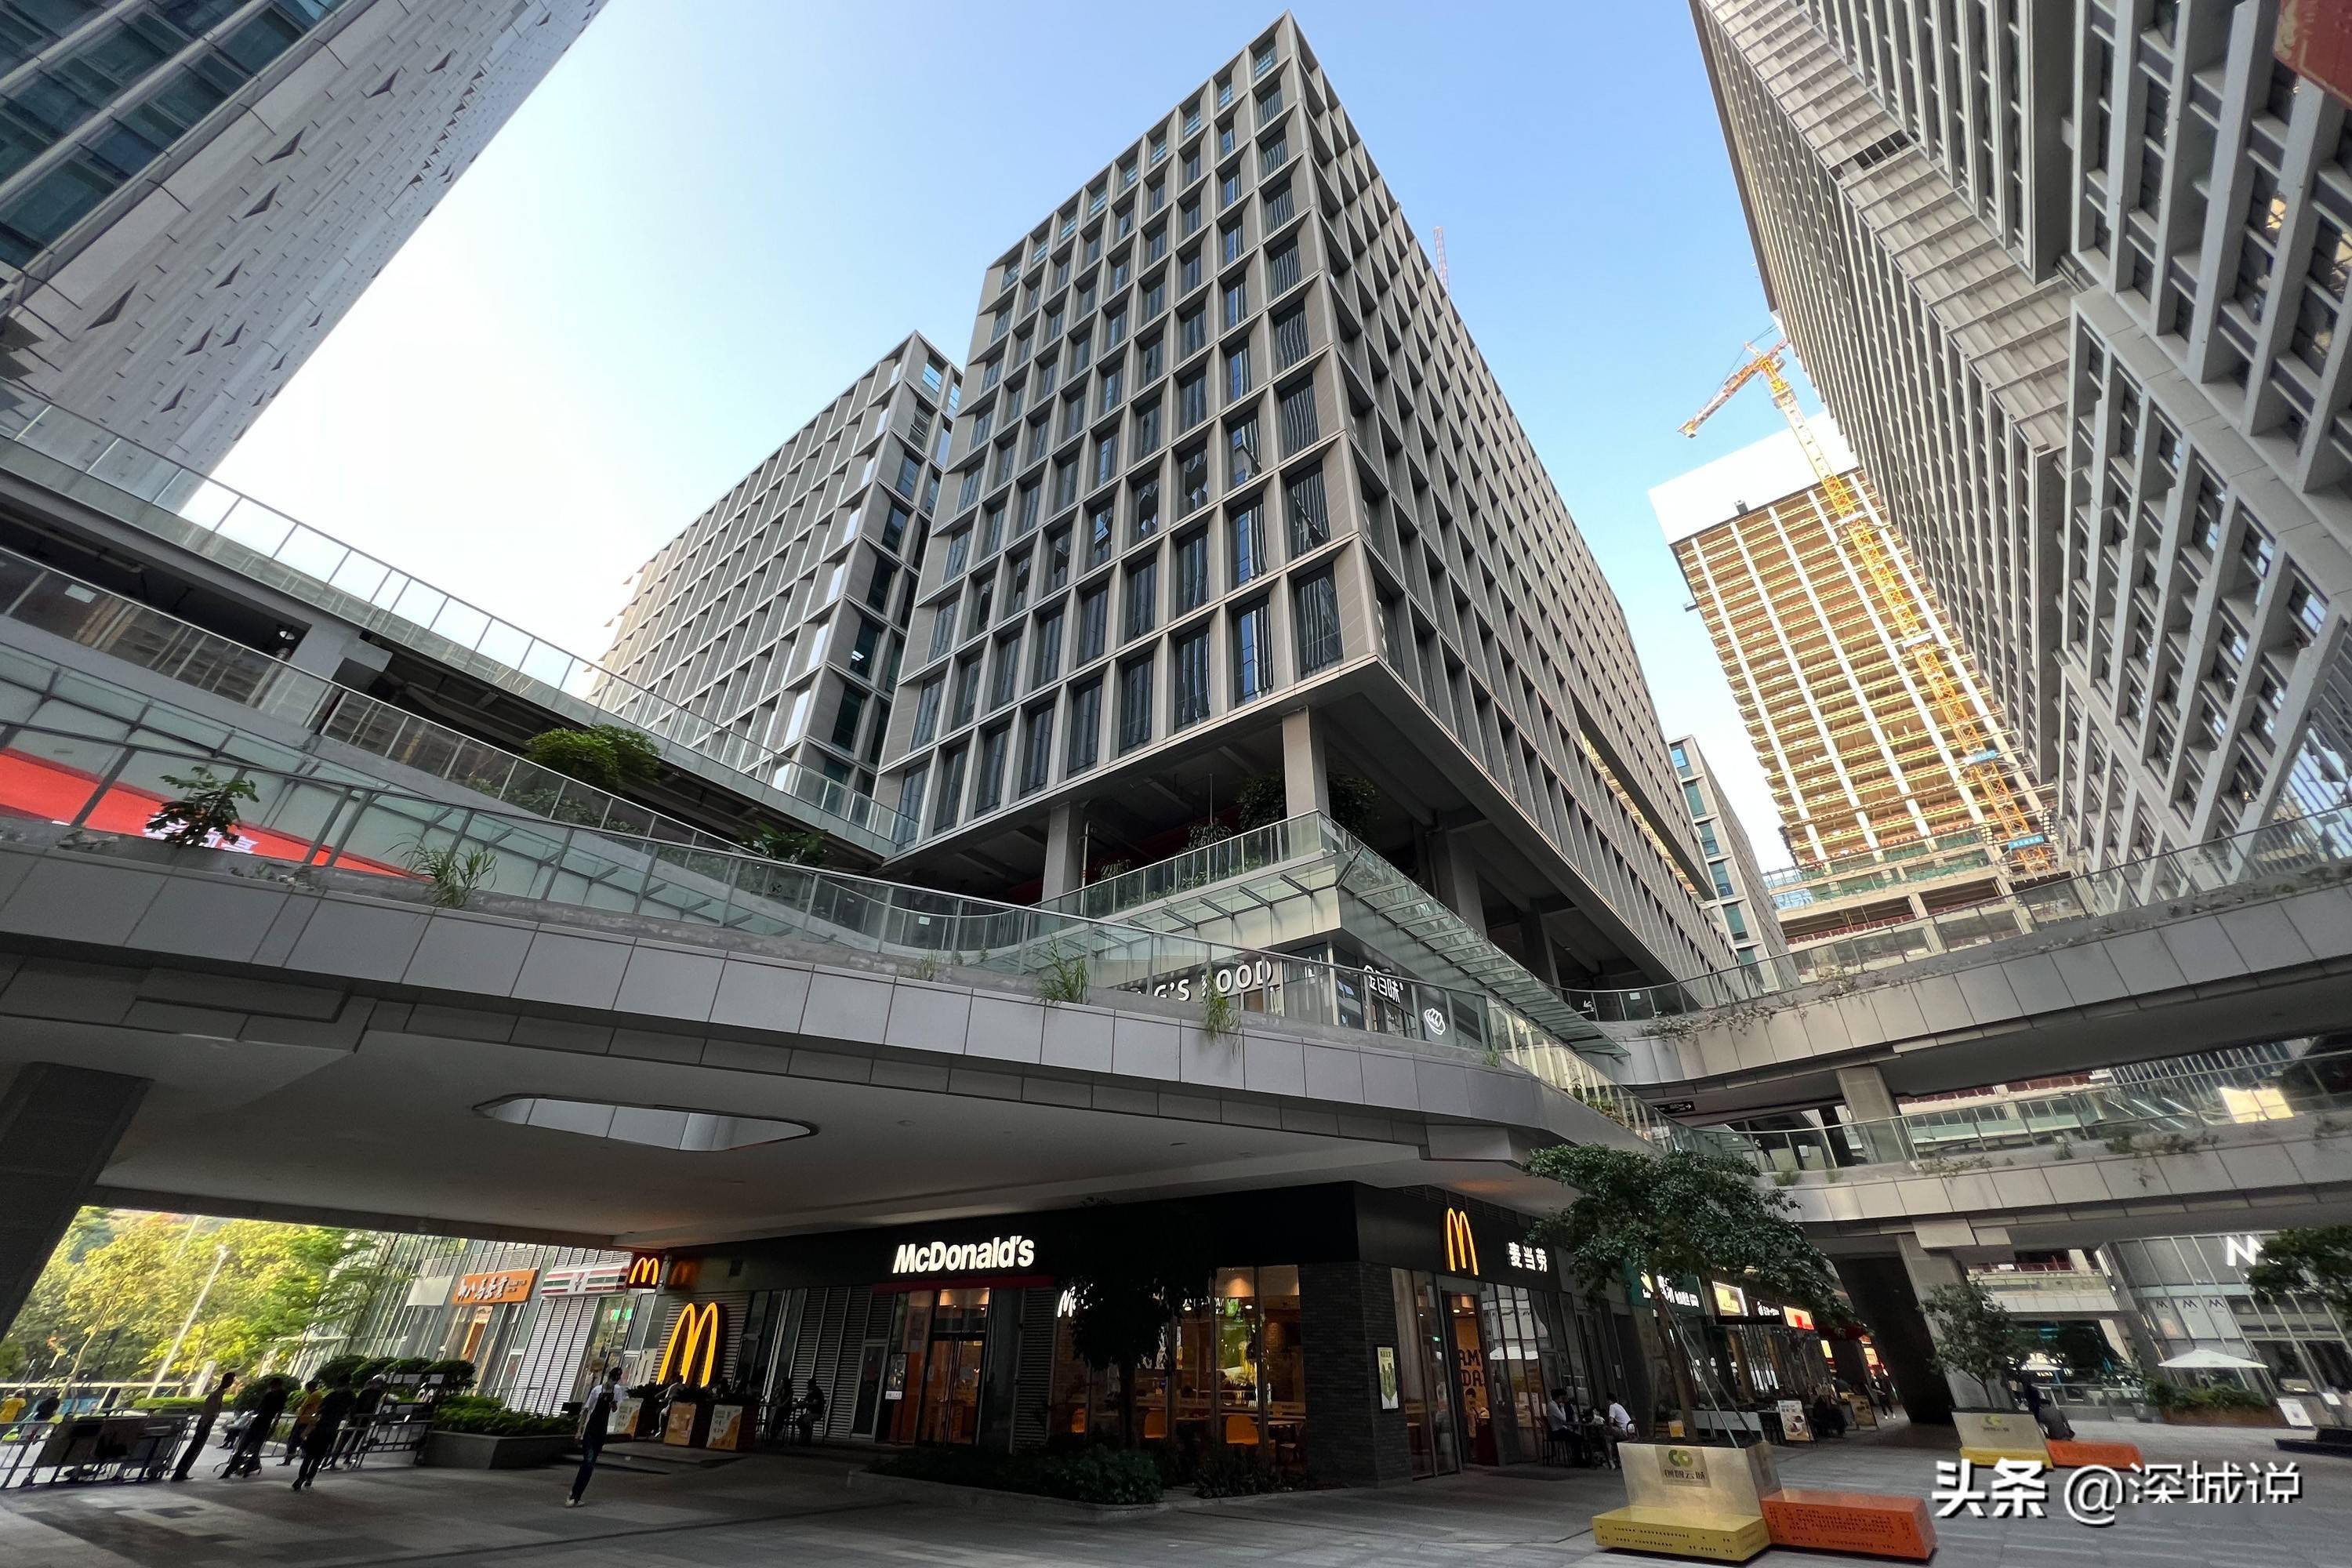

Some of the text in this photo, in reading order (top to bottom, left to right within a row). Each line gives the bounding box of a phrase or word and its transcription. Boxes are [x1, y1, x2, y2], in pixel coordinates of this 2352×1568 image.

[892, 1235, 1036, 1274] McDonald's
[1508, 1242, 1548, 1272] 麦当劳
